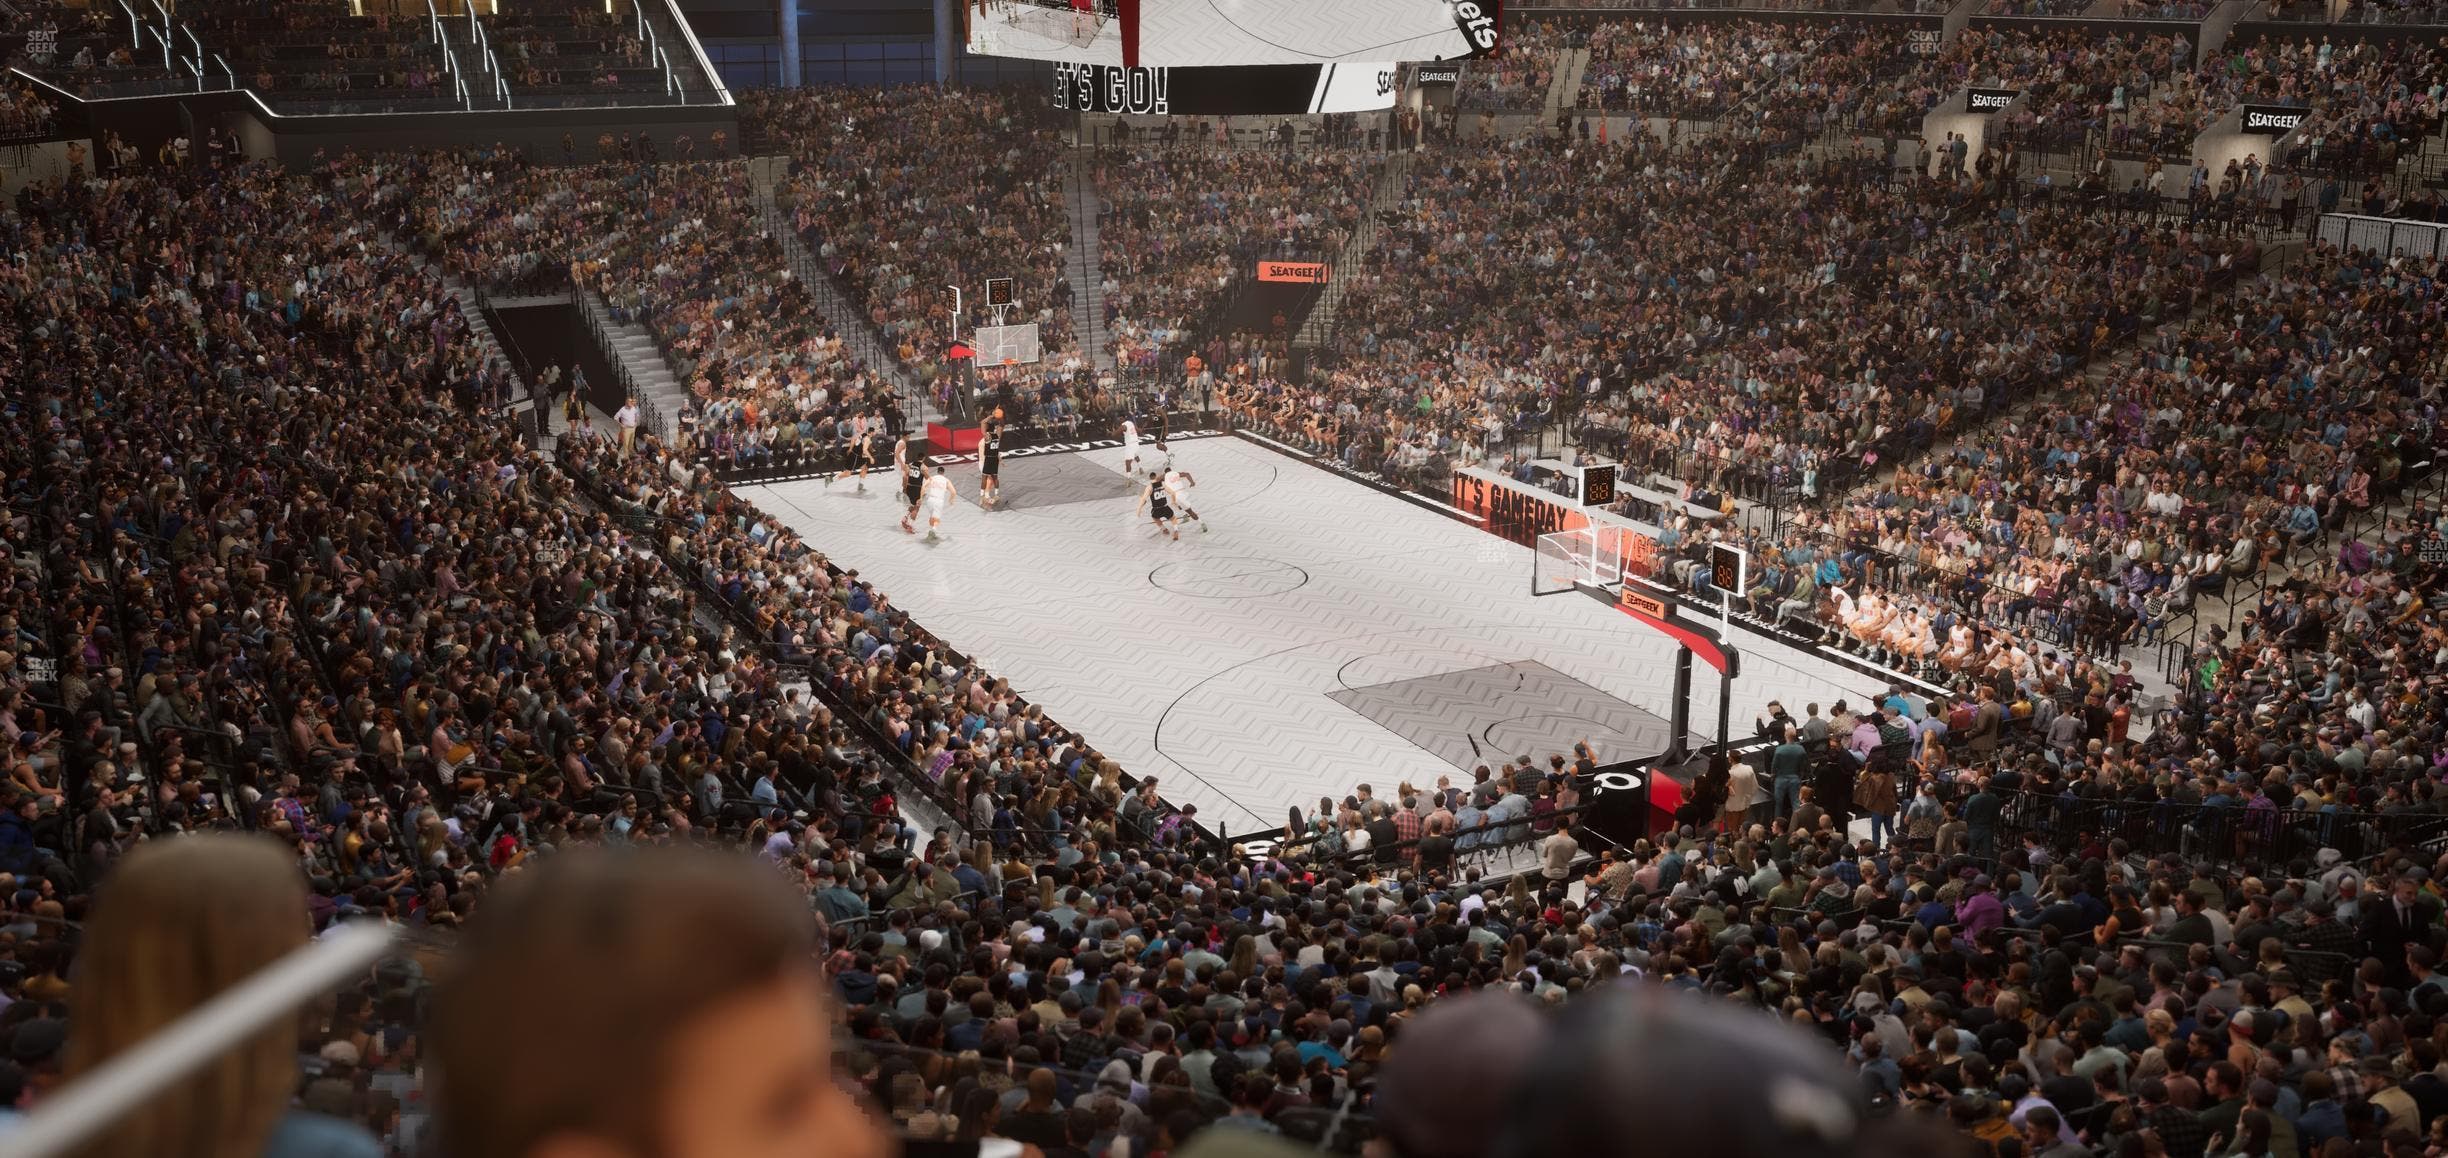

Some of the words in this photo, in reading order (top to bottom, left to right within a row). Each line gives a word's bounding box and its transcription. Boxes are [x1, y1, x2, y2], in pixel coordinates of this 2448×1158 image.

[1450, 0, 1498, 49] ets
[1104, 66, 1168, 114] GO!
[1420, 71, 1457, 82] SEATGEEK
[1269, 265, 1323, 279] SEATGEEK
[927, 437, 1122, 465] Broklyn
[1453, 470, 1484, 507] IT'S
[1490, 484, 1567, 533] GAMEDAY
[1626, 593, 1660, 614] SEATGEEK
